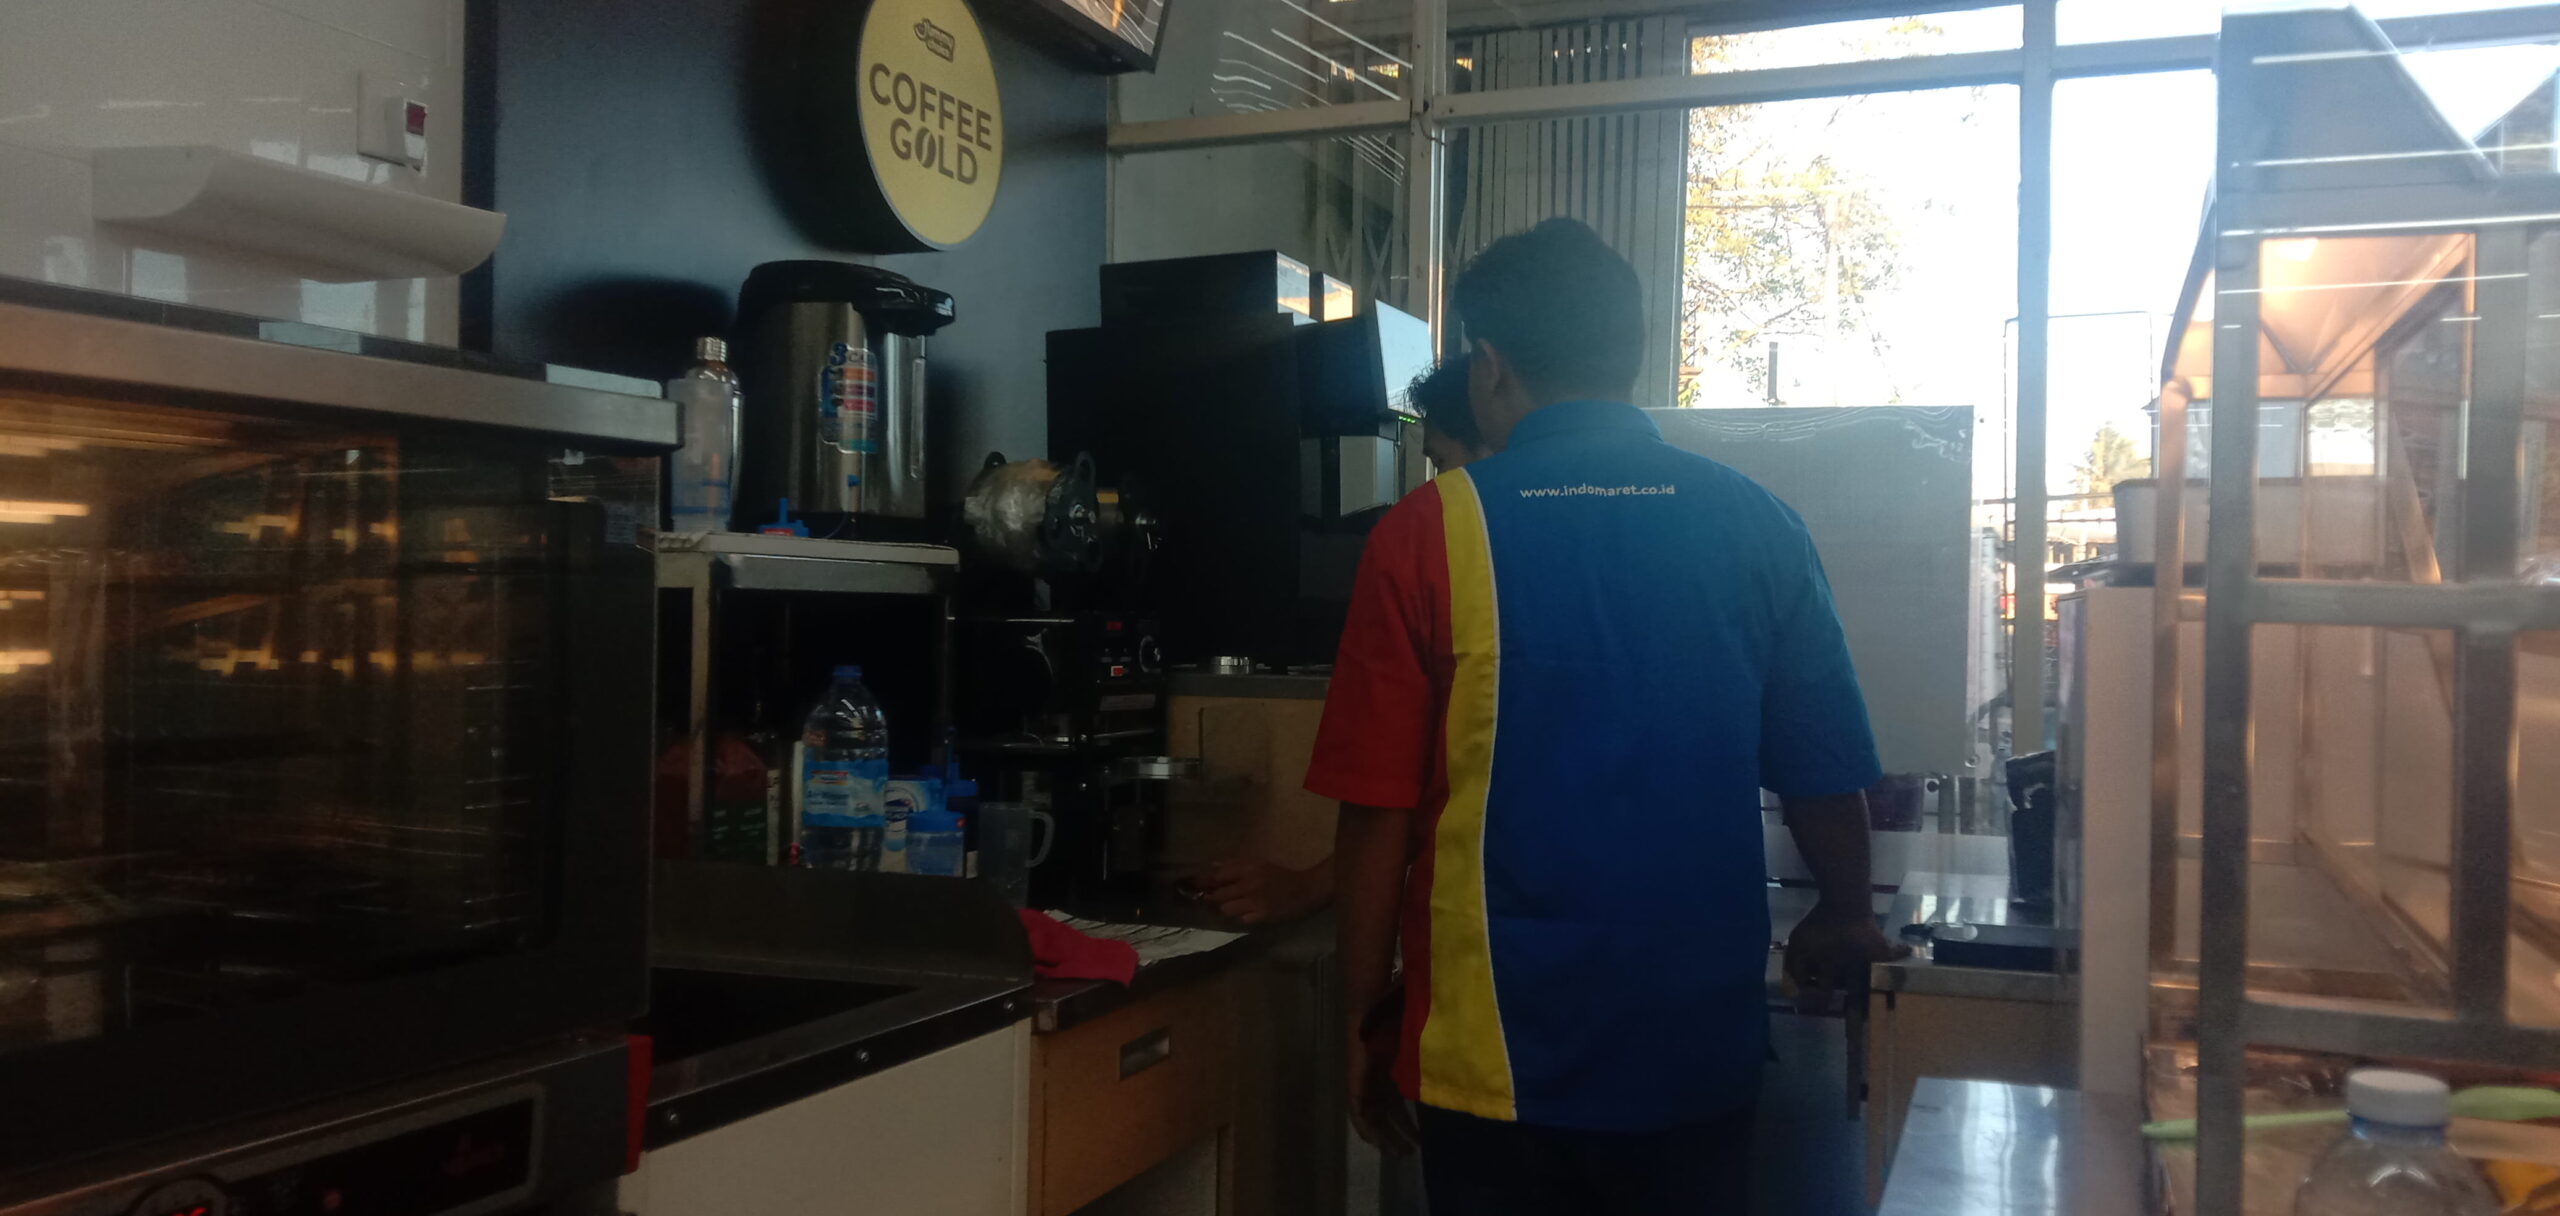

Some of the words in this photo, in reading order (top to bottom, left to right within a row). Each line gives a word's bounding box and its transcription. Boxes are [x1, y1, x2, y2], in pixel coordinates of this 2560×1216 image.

[868, 62, 993, 152] COFFEE
[889, 117, 978, 185] GOLD
[1519, 482, 1676, 499] www.indomaret.co.id
